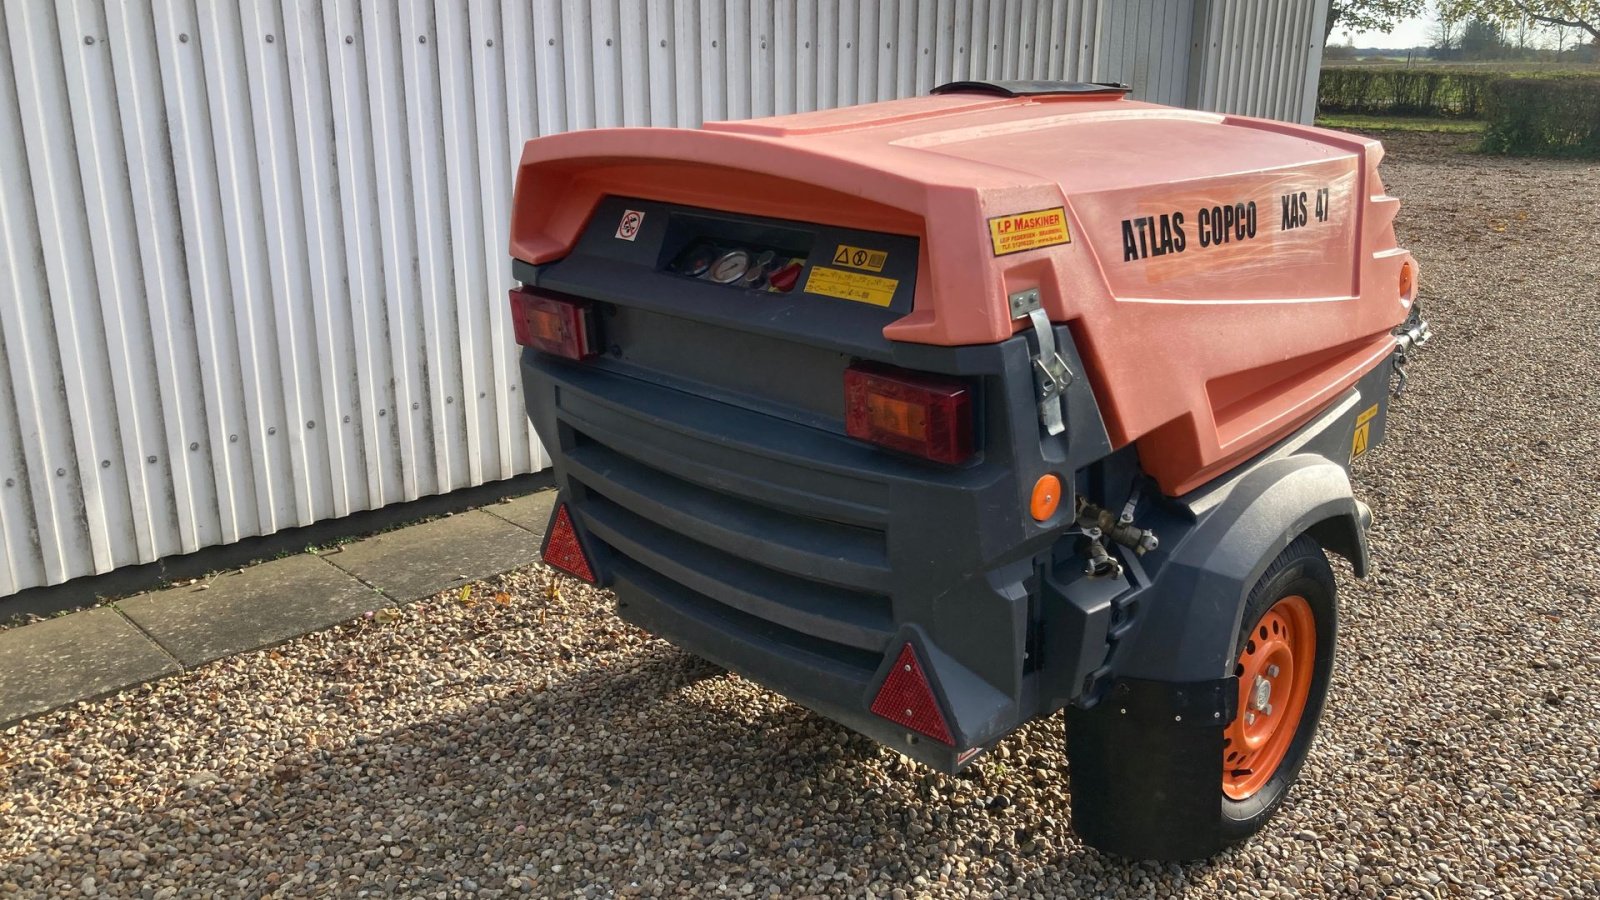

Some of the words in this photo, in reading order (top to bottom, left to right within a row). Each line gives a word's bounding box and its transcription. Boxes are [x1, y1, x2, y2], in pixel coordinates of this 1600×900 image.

[1121, 212, 1186, 262] ATLAS
[1198, 201, 1256, 248] COPCO
[1281, 191, 1307, 231] XAS
[1315, 188, 1329, 223] 47
